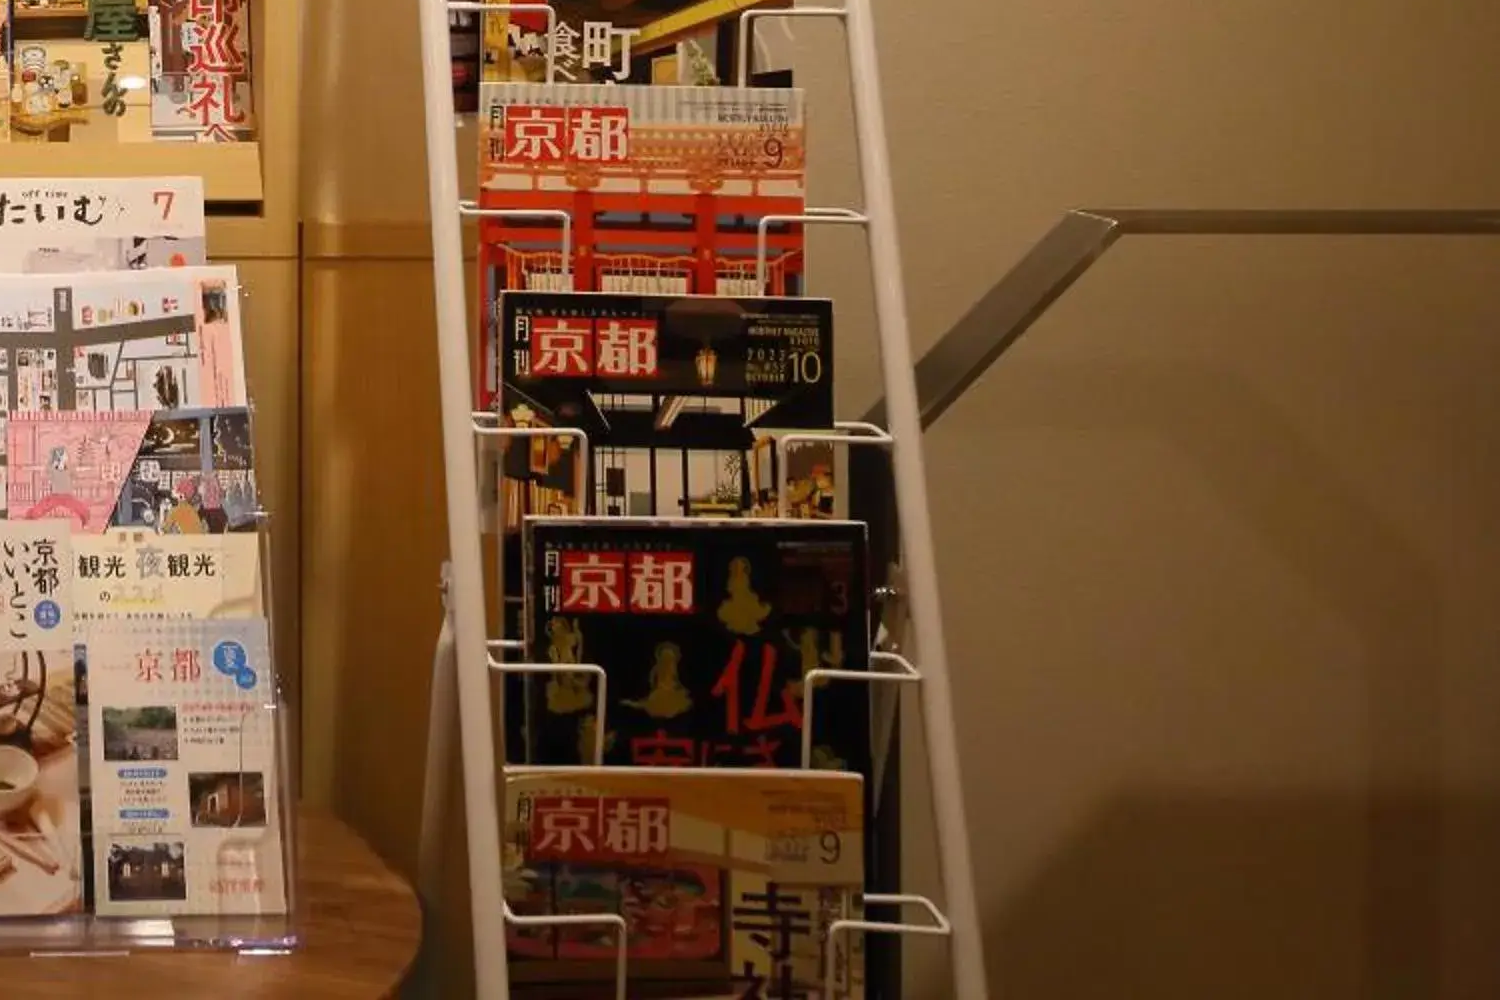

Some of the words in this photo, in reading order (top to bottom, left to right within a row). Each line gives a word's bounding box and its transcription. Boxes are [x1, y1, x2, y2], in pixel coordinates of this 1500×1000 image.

[490, 105, 505, 162] 月刊
[507, 108, 629, 161] 京都
[763, 137, 783, 169] 9
[153, 191, 175, 221] 7
[514, 315, 530, 376] 月刊
[532, 319, 658, 375] 京都
[787, 350, 822, 384] 10
[31, 538, 59, 596] 京都
[77, 553, 127, 579] 観光
[543, 550, 561, 613] 月刊
[563, 553, 694, 611] 京都
[3, 540, 30, 639] いいとこ
[134, 647, 201, 684] 京都
[536, 799, 670, 853] 京都
[819, 830, 841, 865] 9
